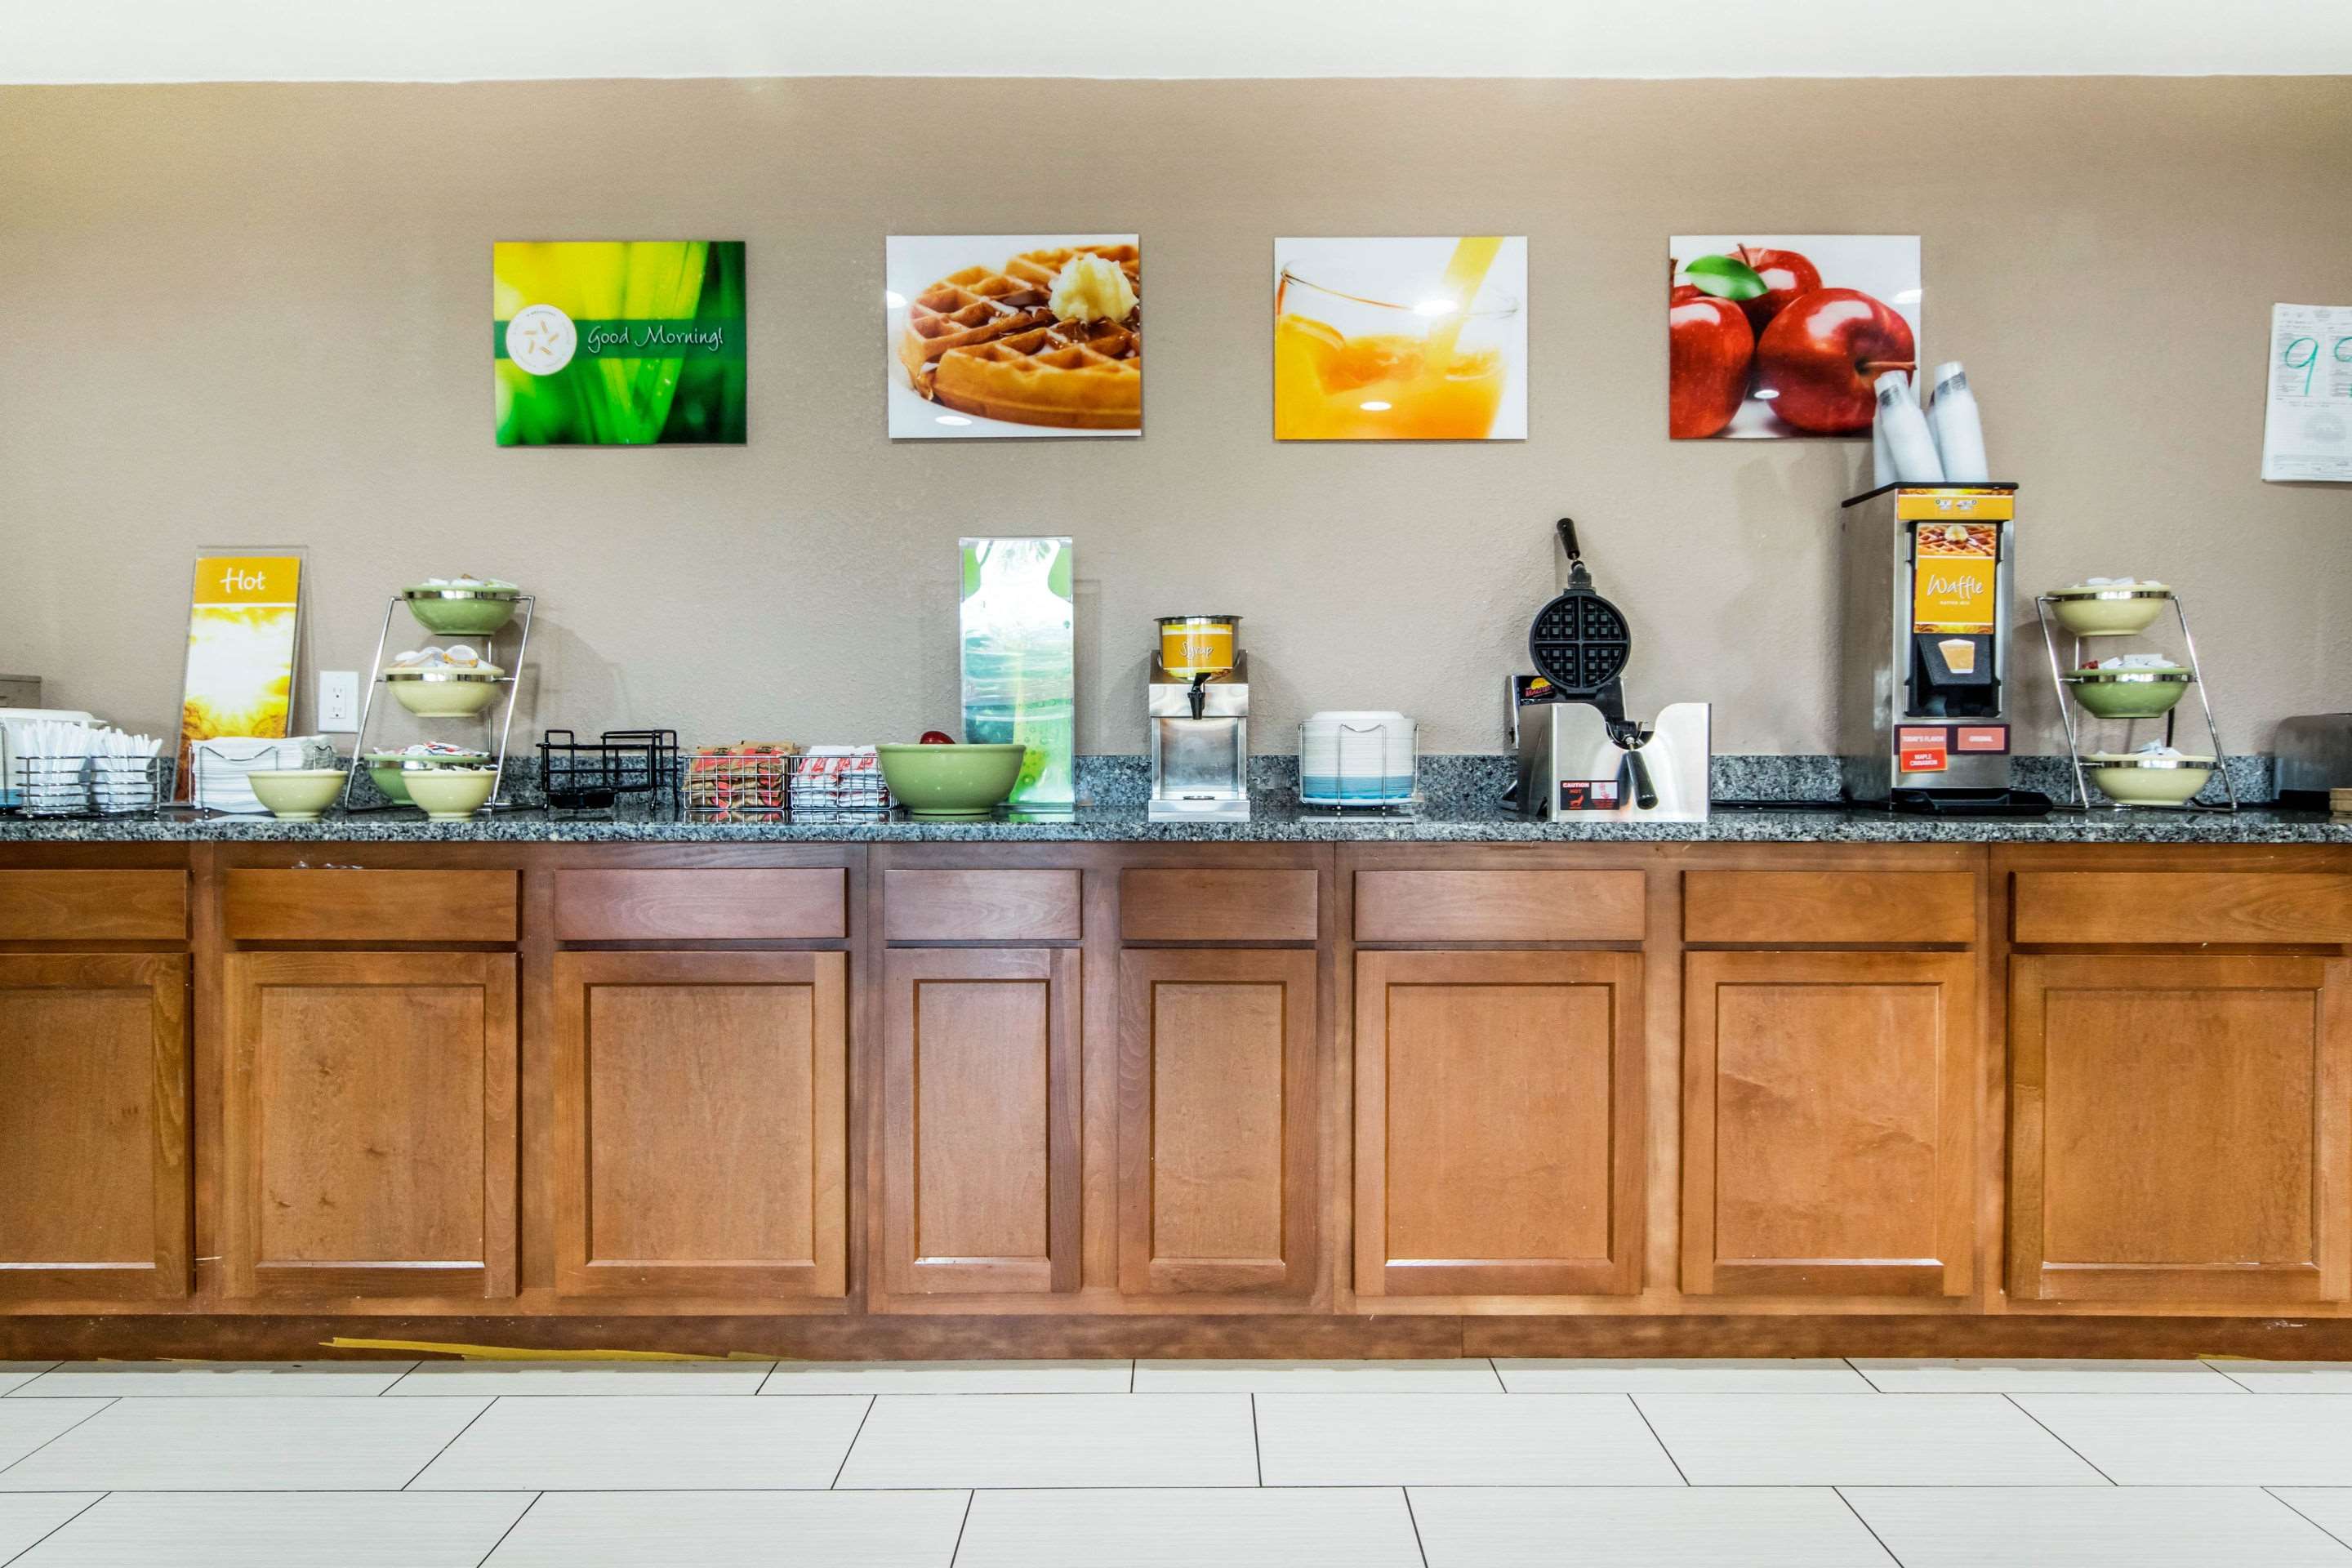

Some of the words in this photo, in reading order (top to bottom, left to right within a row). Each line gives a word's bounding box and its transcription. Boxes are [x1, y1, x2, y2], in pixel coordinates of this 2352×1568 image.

[588, 326, 629, 354] Good
[635, 325, 724, 352] Morning!
[219, 567, 267, 594] Hot
[1927, 574, 1984, 599] Waffle
[1180, 640, 1215, 660] Syrup
